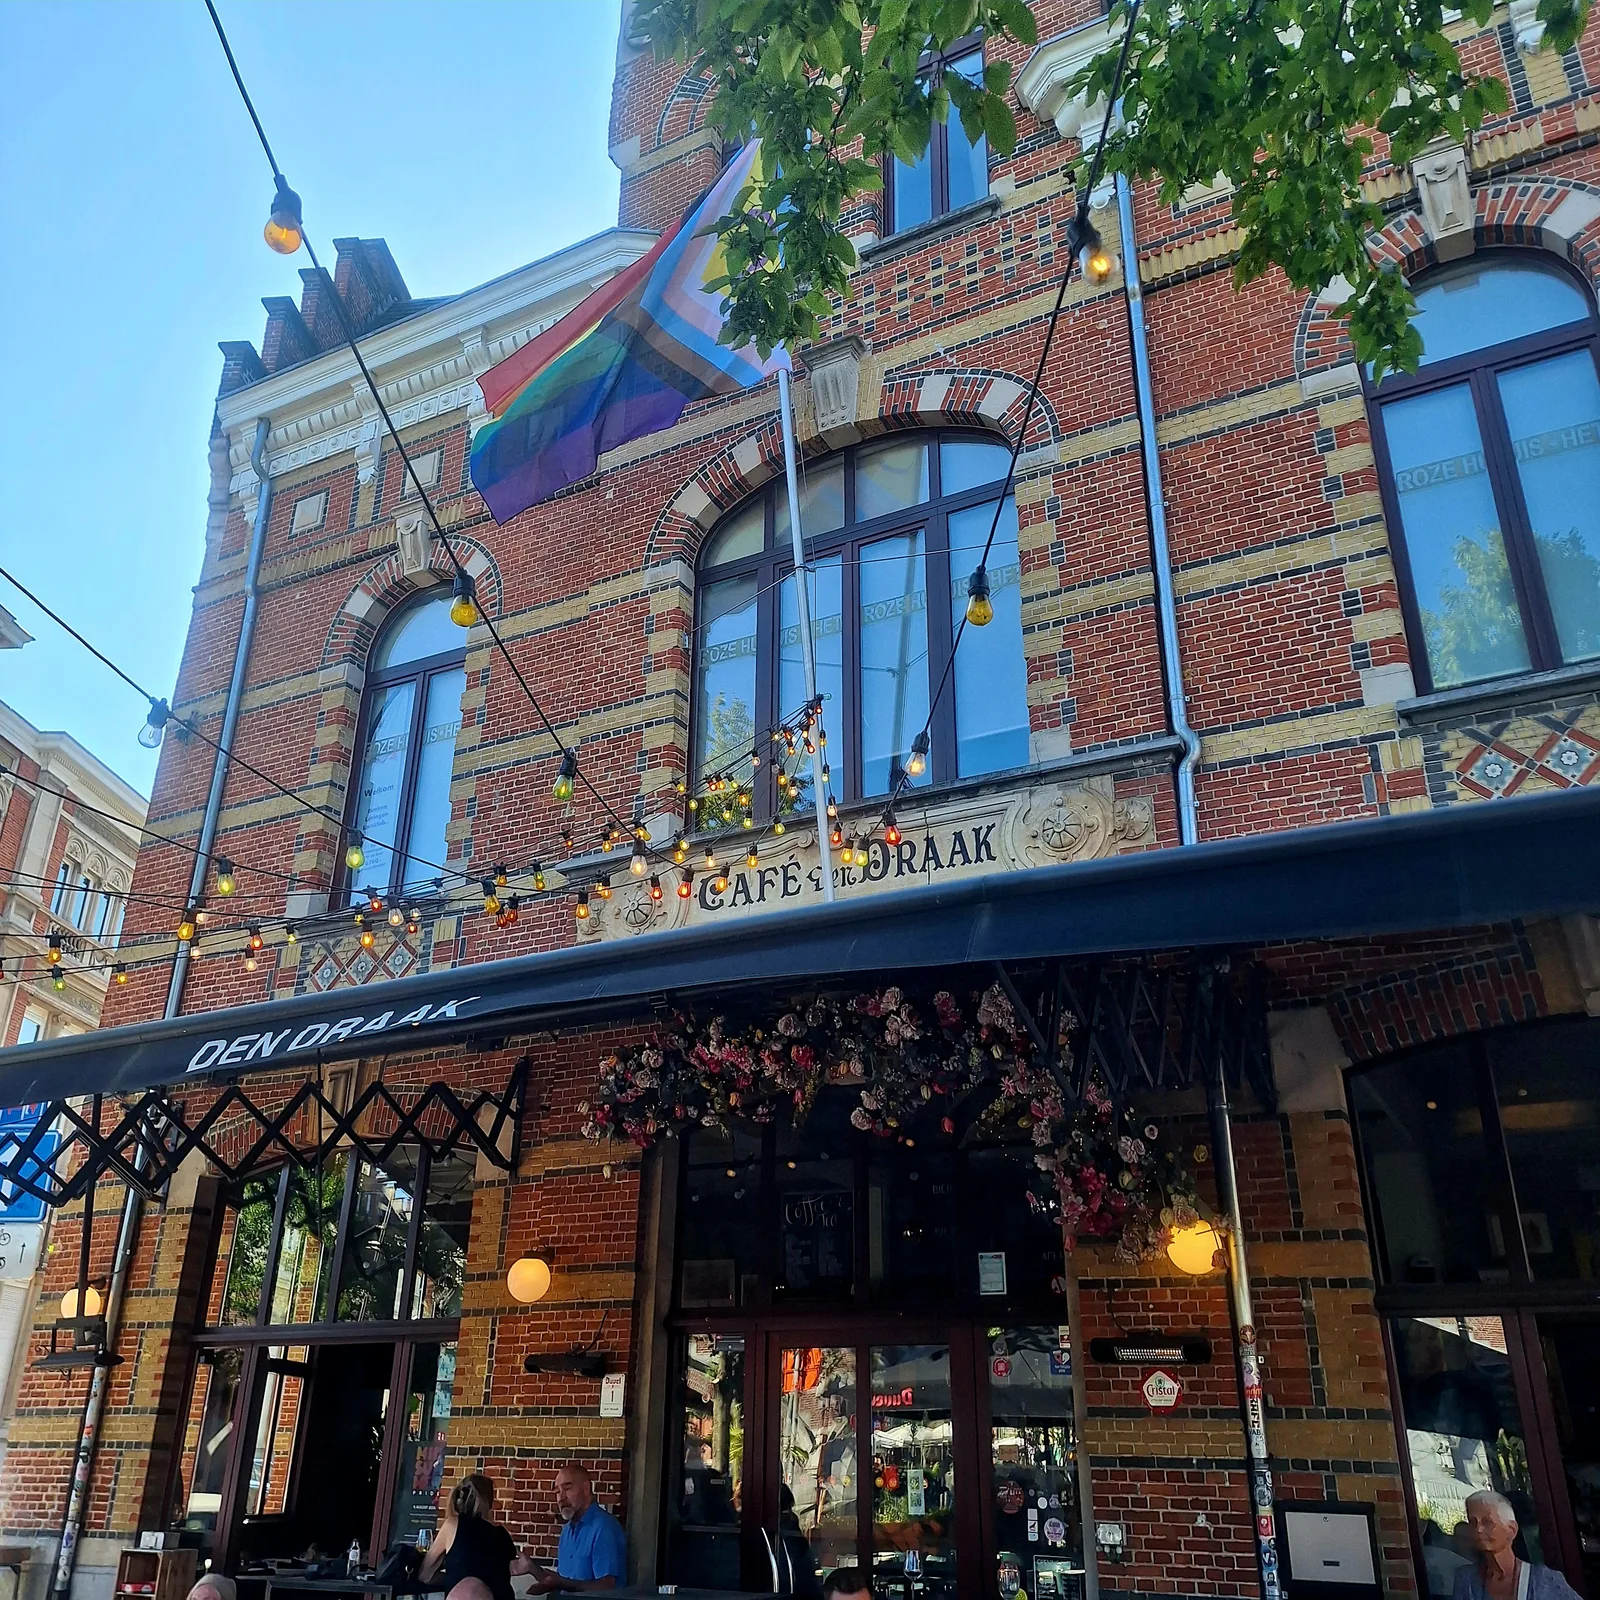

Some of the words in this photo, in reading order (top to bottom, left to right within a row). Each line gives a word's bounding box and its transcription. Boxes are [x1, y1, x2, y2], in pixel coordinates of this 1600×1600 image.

[1397, 461, 1457, 491] ROZE
[864, 599, 904, 621] ROZE
[368, 738, 394, 756] OZE
[445, 722, 460, 738] HE
[364, 784, 394, 798] Welkom
[699, 854, 801, 911] CAFÉ
[859, 822, 997, 883] DRAAK
[185, 1028, 291, 1073] DEN
[287, 996, 481, 1051] DRAAK
[785, 1194, 825, 1226] Coffee
[1146, 1383, 1175, 1398] Cristal
